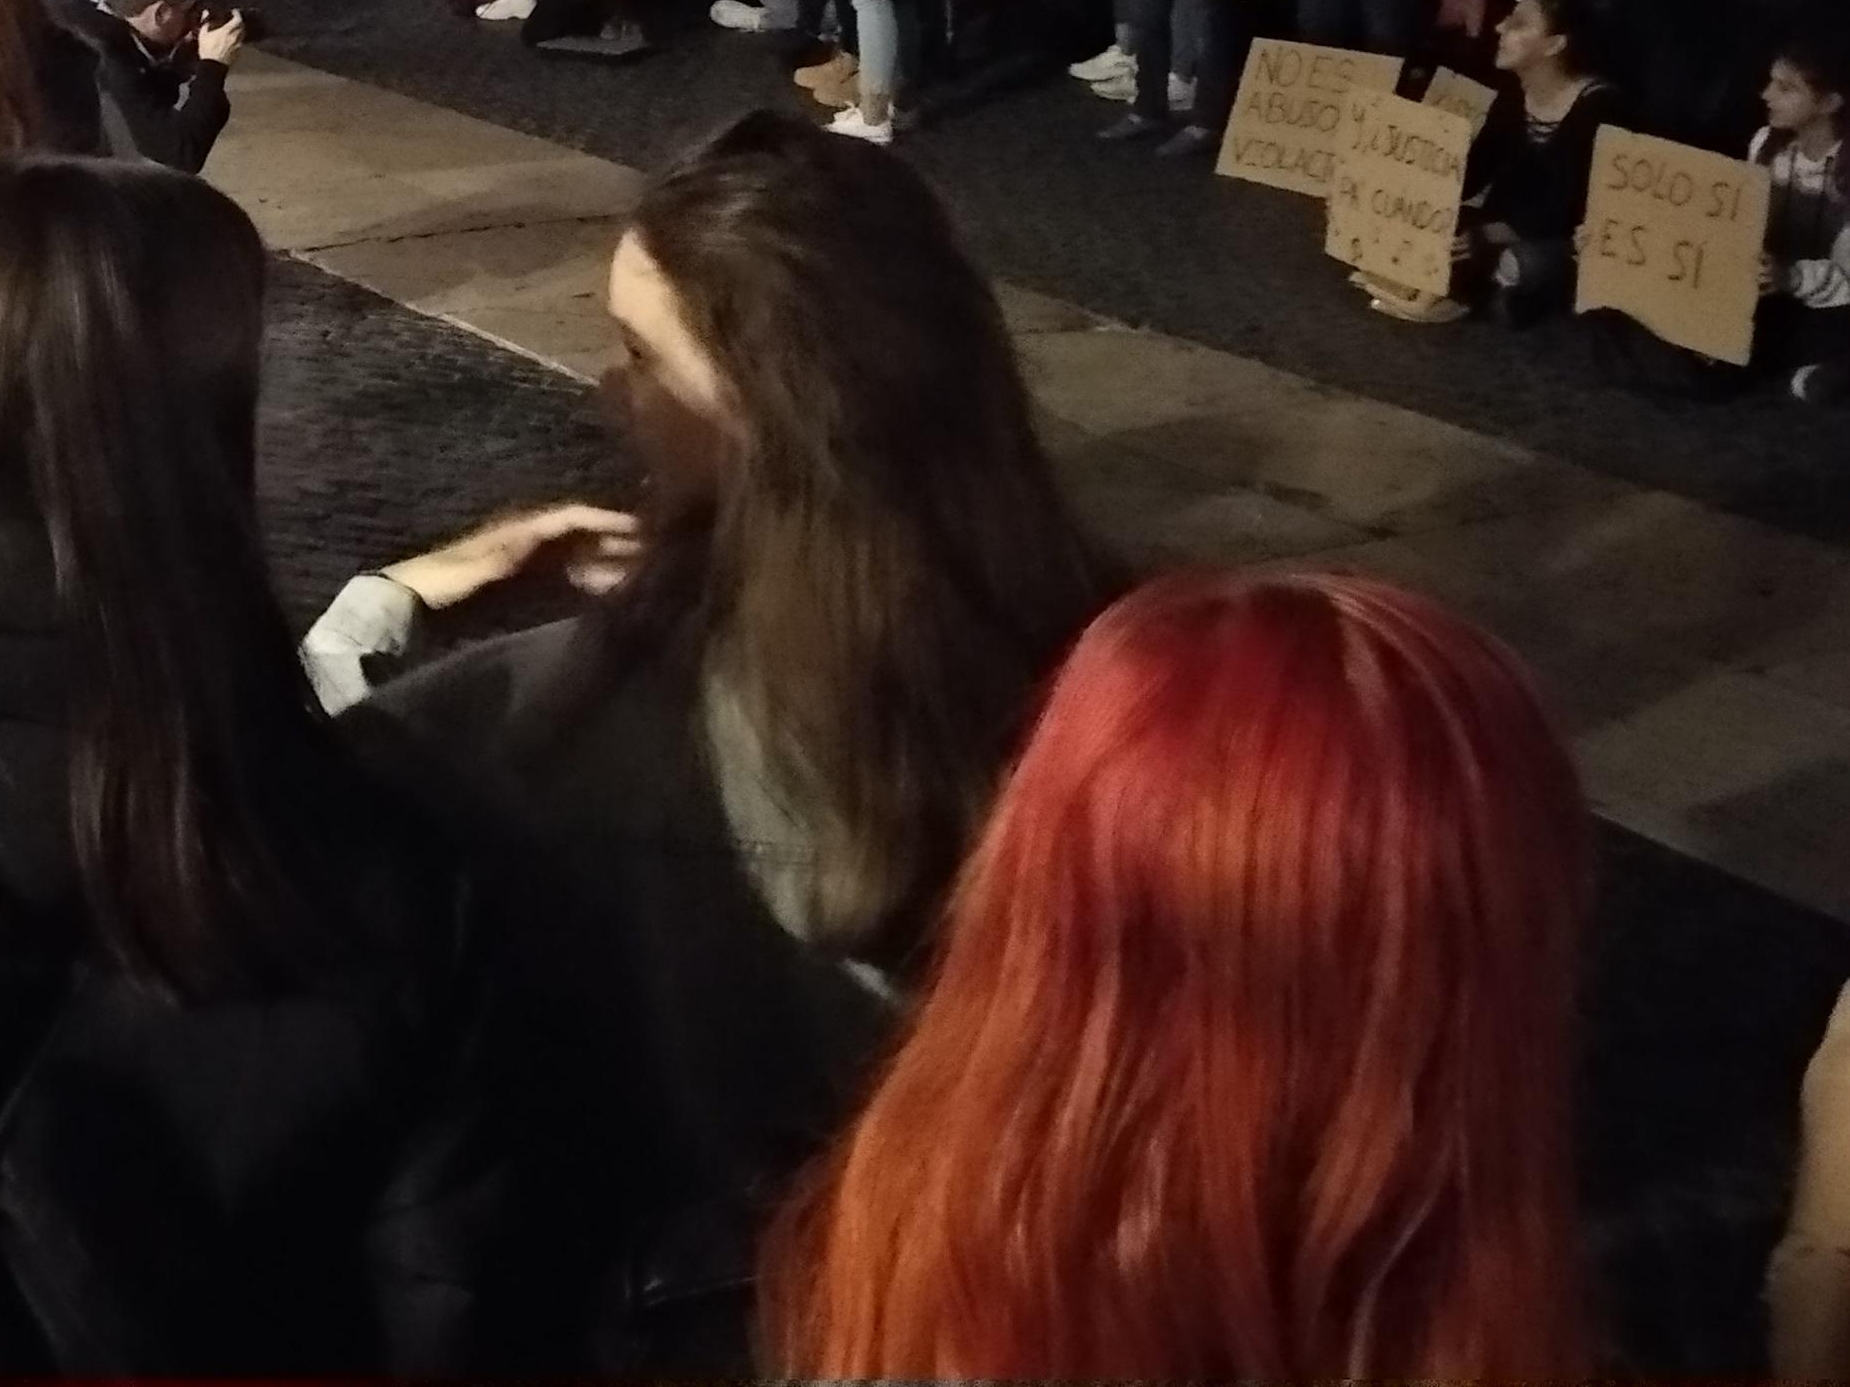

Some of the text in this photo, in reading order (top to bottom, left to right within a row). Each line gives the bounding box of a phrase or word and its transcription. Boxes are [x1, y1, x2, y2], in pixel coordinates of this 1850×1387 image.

[1255, 47, 1355, 93] NO ES
[1608, 153, 1692, 206] SOLO
[1601, 217, 1646, 266] ES
